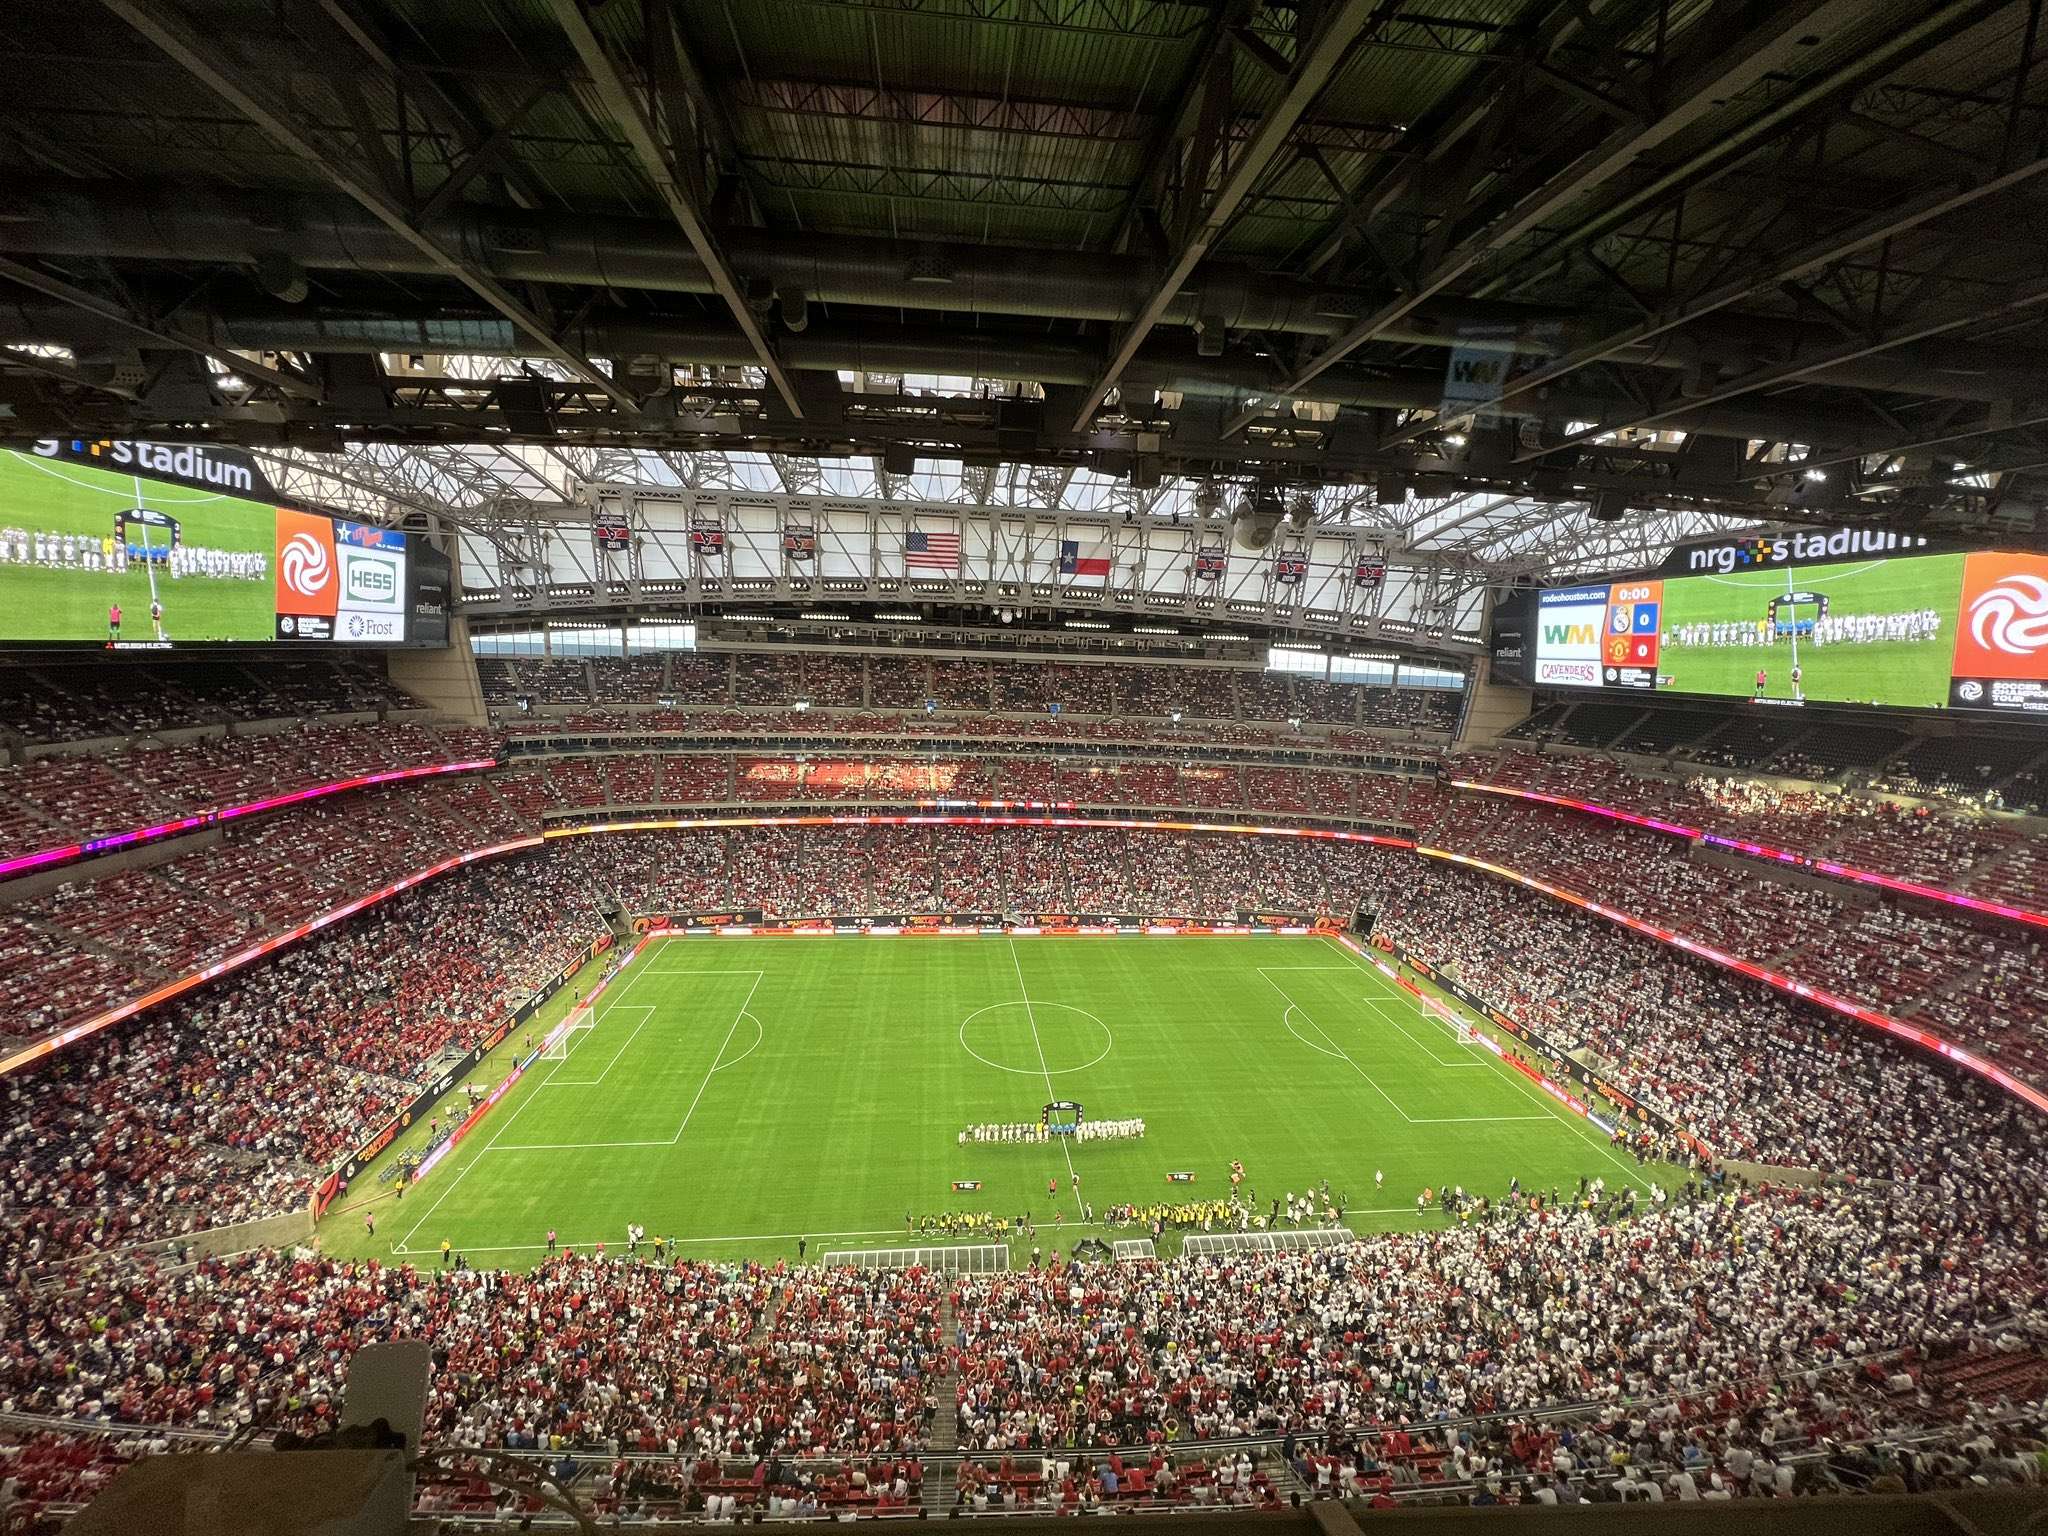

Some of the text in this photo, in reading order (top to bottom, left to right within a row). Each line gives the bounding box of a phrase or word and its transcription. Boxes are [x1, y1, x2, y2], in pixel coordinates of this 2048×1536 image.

[111, 440, 251, 490] stadium
[1690, 547, 1736, 574] nrg
[352, 570, 392, 590] HESS
[1542, 591, 1606, 603] rodeohouston.com
[1619, 587, 1650, 600] 0:00
[416, 601, 442, 615] reliant
[366, 619, 392, 635] Frost
[1639, 614, 1649, 626] 0
[1544, 624, 1596, 645] WM
[1496, 647, 1521, 658] reliant
[1637, 644, 1648, 656] 0
[1541, 664, 1595, 682] CAVENDER'S
